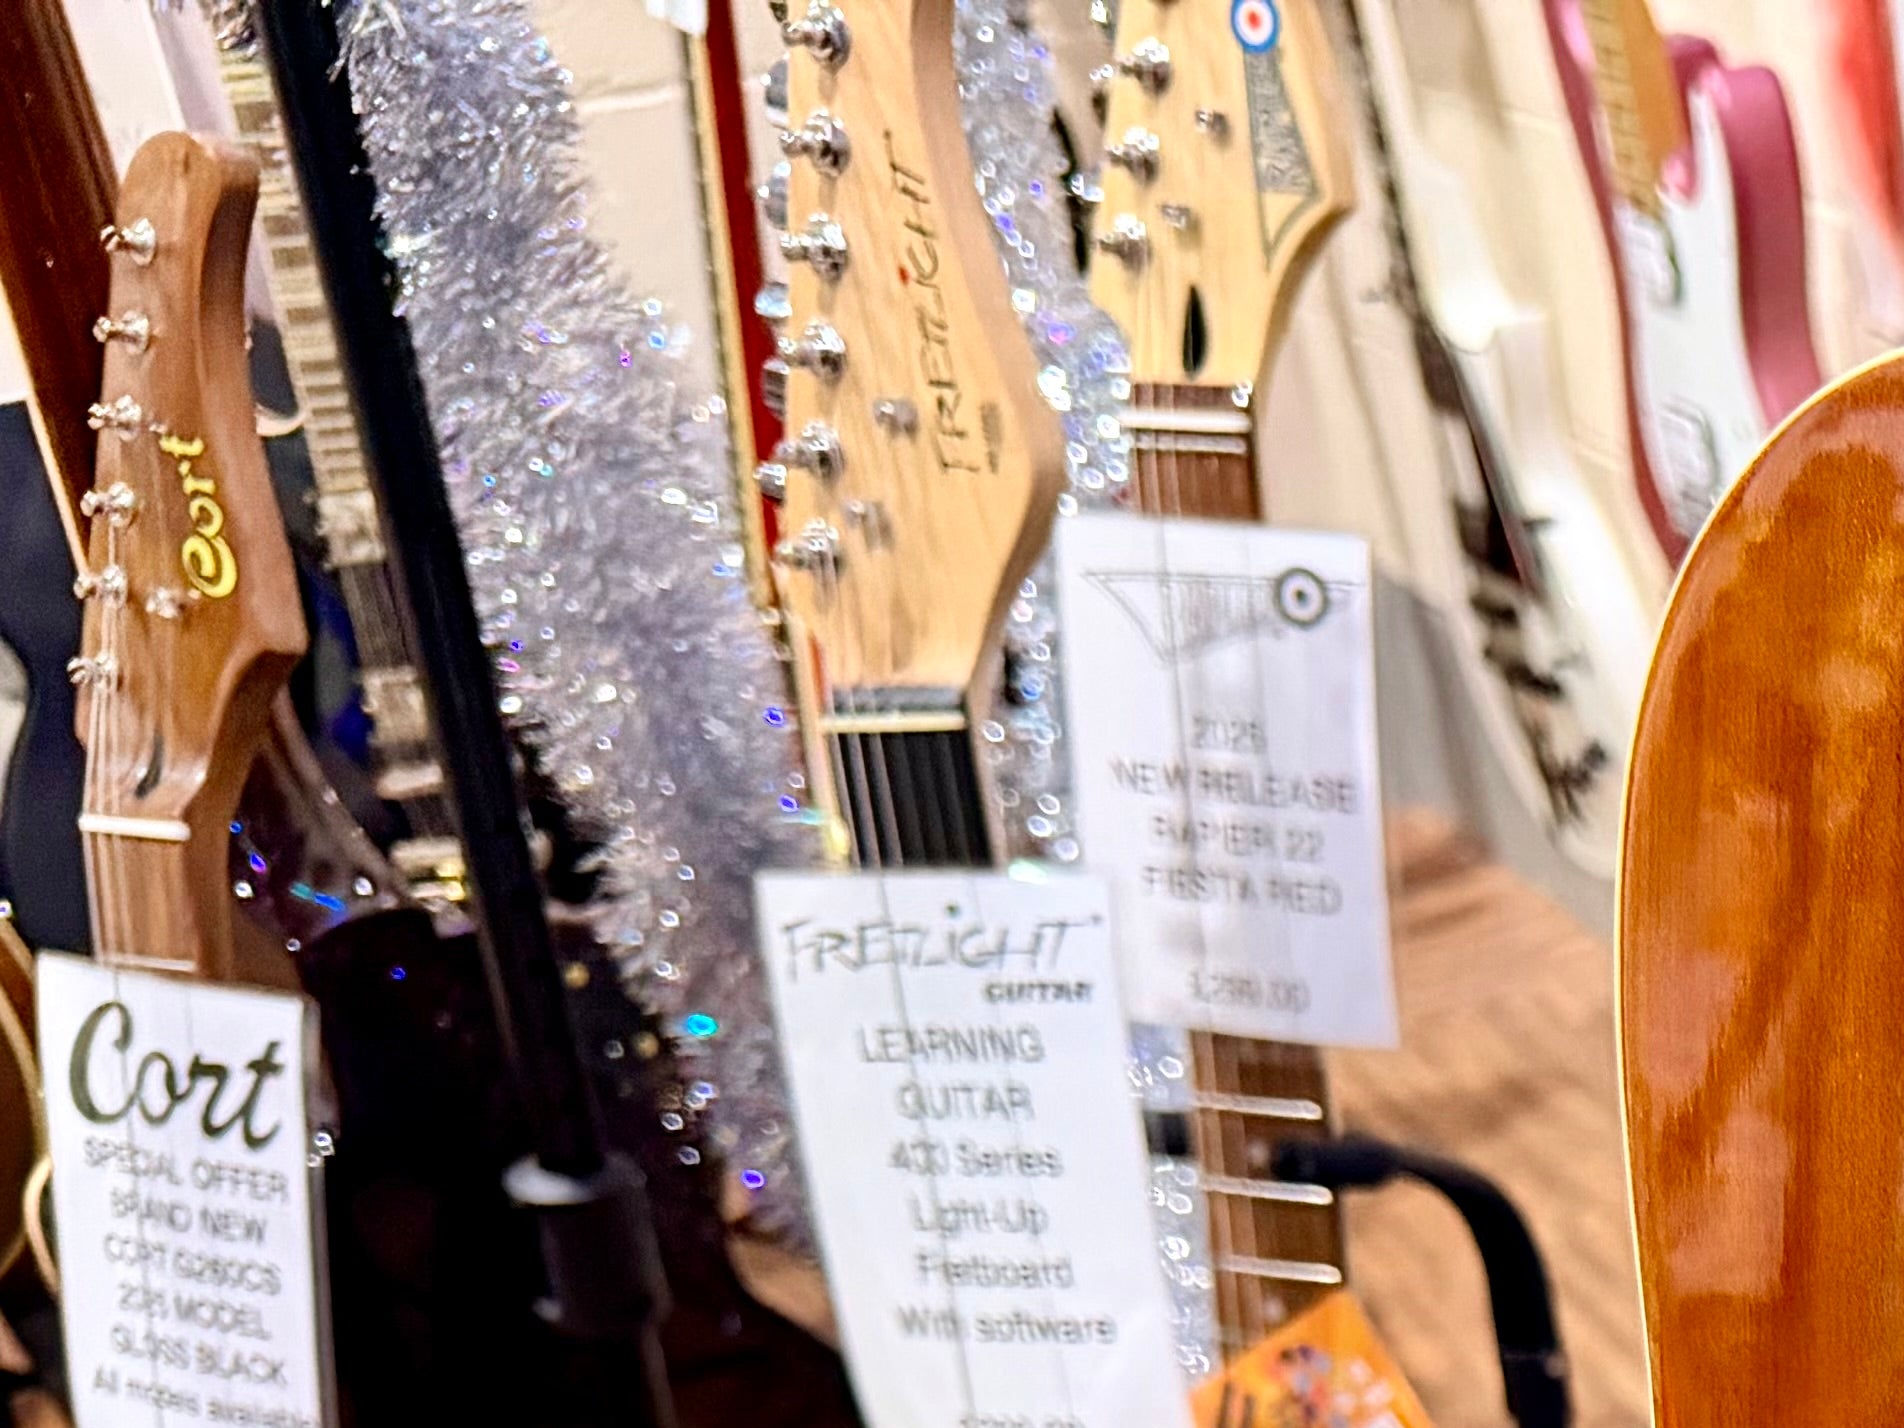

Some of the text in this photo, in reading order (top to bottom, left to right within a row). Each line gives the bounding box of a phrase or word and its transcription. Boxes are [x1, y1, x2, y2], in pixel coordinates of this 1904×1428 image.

[158, 434, 239, 600] Cort
[1108, 756, 1358, 815] NEW RELEASE
[1264, 876, 1344, 916] RED
[858, 1023, 1047, 1064] LEARNING
[69, 1000, 285, 1150] Cort
[897, 1080, 1037, 1122] GUITAR
[83, 1134, 290, 1205] SPECIAL OFFER
[957, 1138, 1065, 1179] Series
[109, 1184, 269, 1245] BRAND NEW
[173, 1294, 273, 1342] MODEL
[974, 1311, 1118, 1345] software
[110, 1323, 289, 1388] GLOSS BLACK
